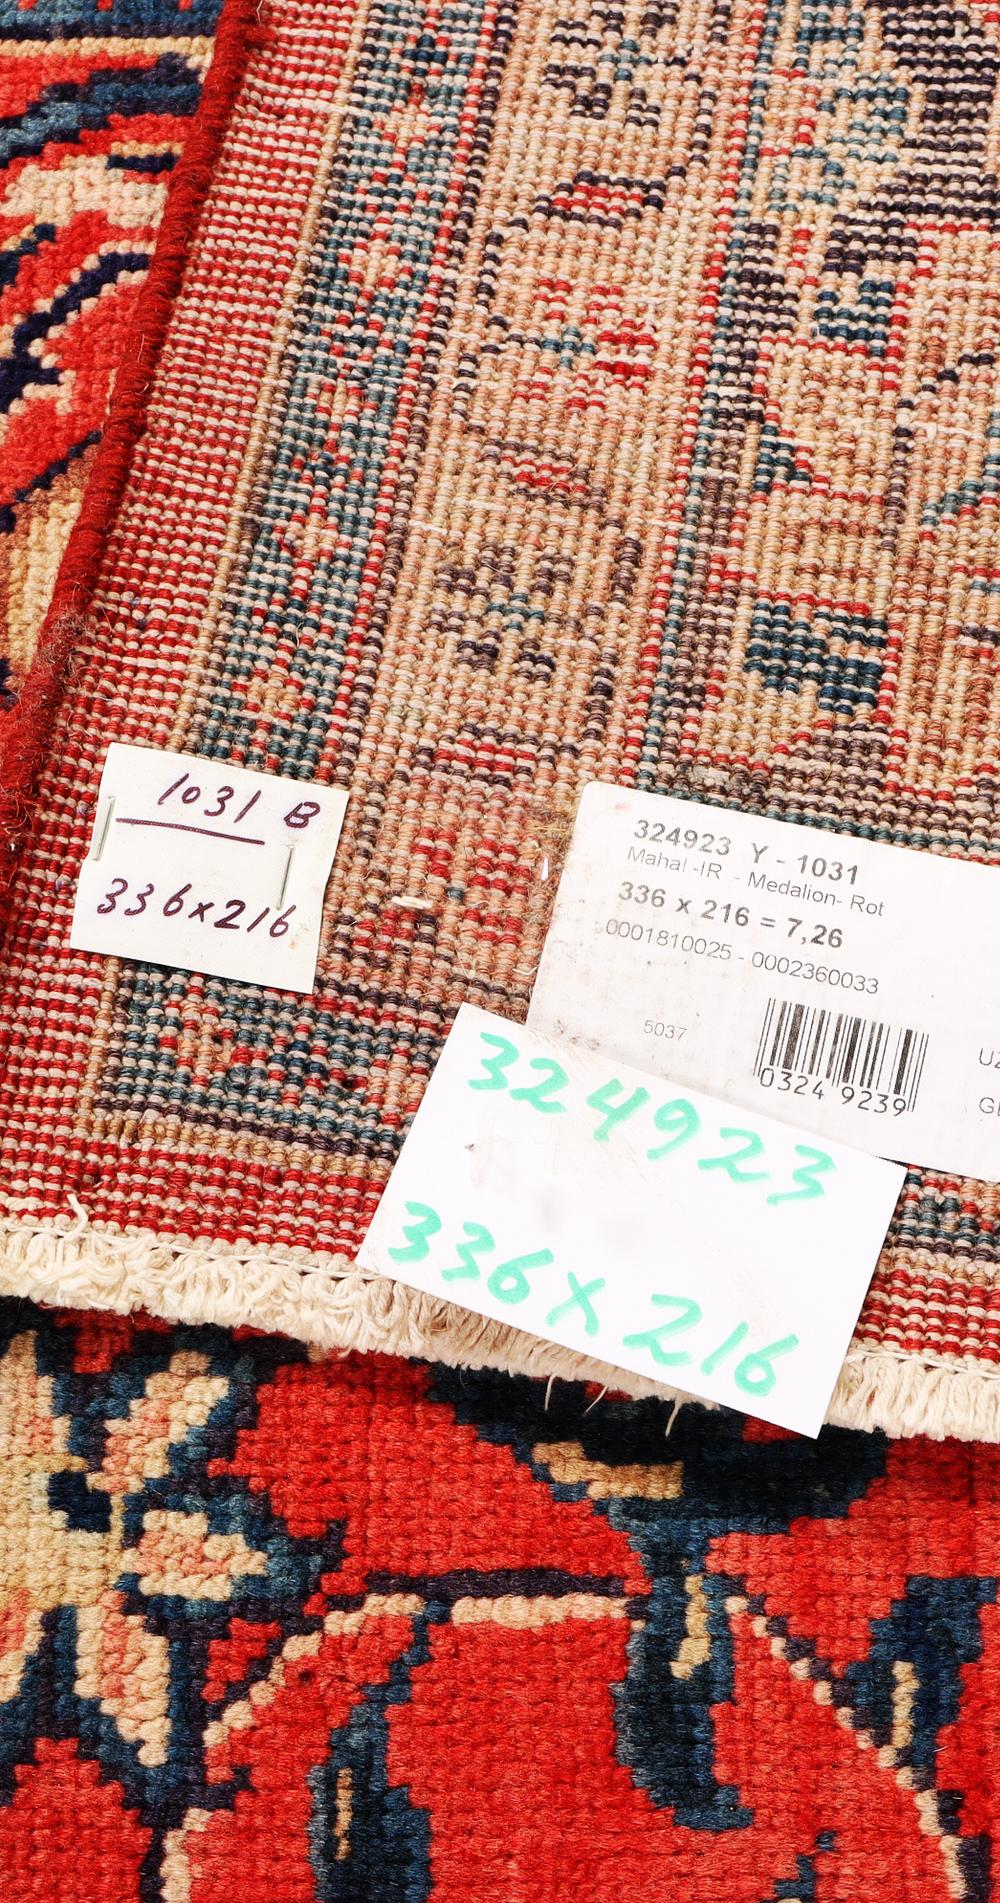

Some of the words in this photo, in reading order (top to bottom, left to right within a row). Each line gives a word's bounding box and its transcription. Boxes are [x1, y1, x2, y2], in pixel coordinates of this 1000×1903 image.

[158, 773, 262, 823] 1031
[283, 801, 321, 829] B
[626, 845, 688, 873] Mahal
[850, 894, 885, 917] Rot
[633, 819, 732, 856] 324923
[751, 842, 769, 864] Y
[797, 854, 858, 886] 1031
[618, 881, 667, 909] 336
[675, 897, 692, 915] x
[700, 899, 751, 927] 216
[760, 916, 777, 928] =
[786, 917, 843, 949] 7,26
[605, 918, 733, 961] 0001810025
[751, 950, 879, 995] 0002360033
[642, 1019, 688, 1041] 5037
[468, 1032, 838, 1206] 324923
[759, 1067, 825, 1100] 0324
[841, 1086, 907, 1117] 9239
